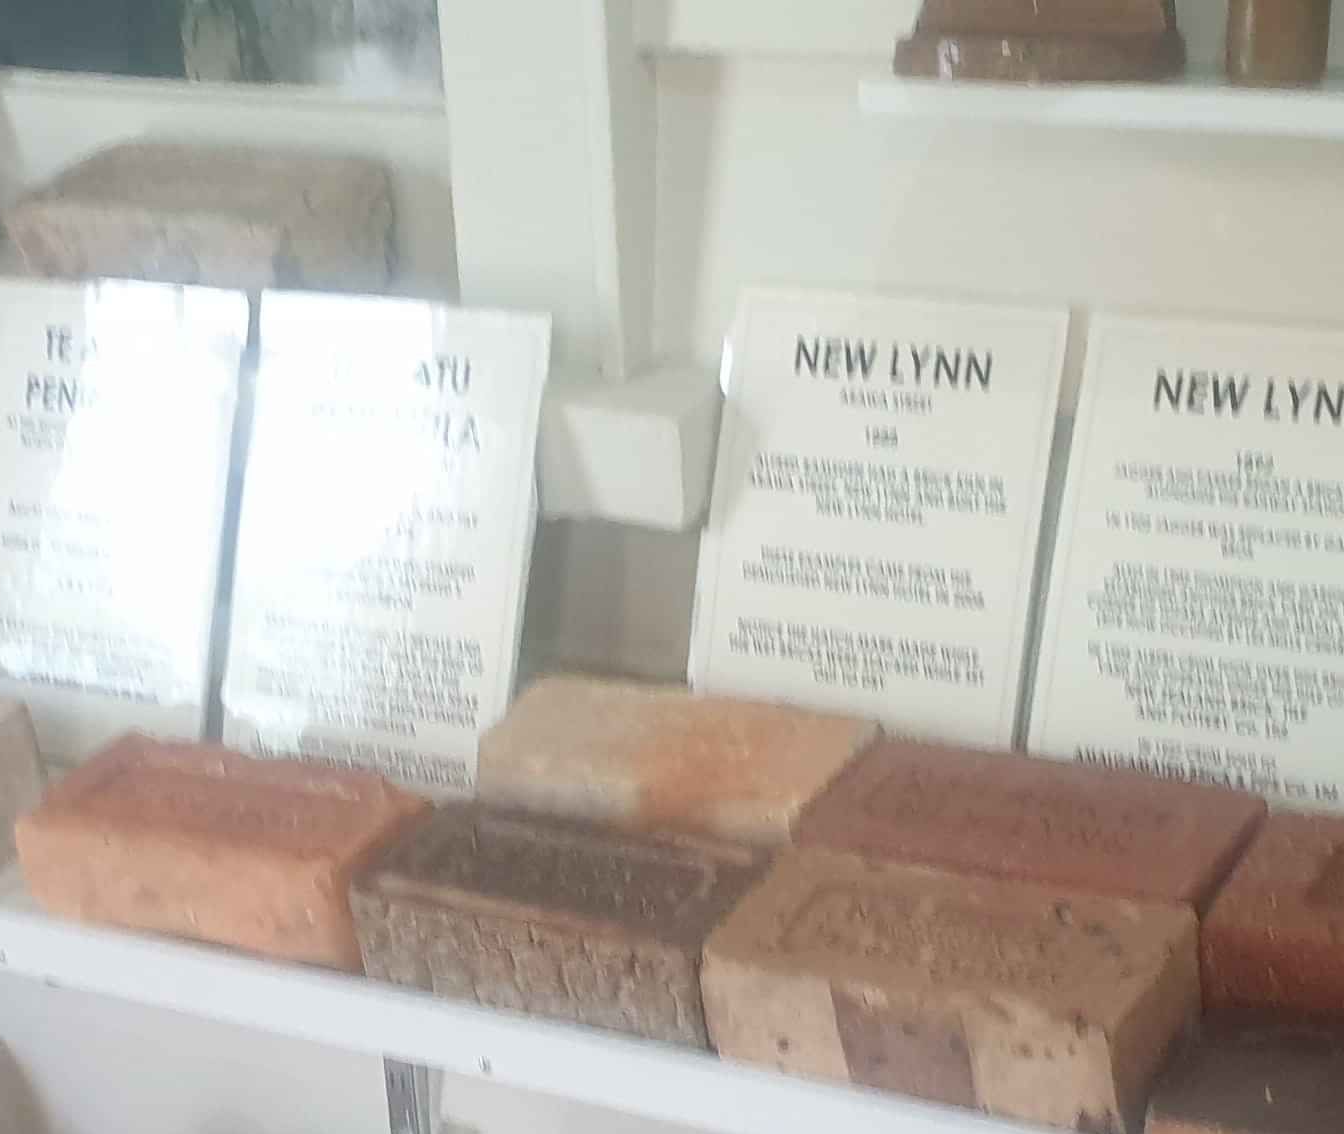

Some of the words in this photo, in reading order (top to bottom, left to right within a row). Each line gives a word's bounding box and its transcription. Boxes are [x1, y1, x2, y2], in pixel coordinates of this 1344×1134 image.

[794, 333, 877, 380] NEW
[889, 340, 993, 392] LYNN
[1153, 368, 1250, 417] NEW
